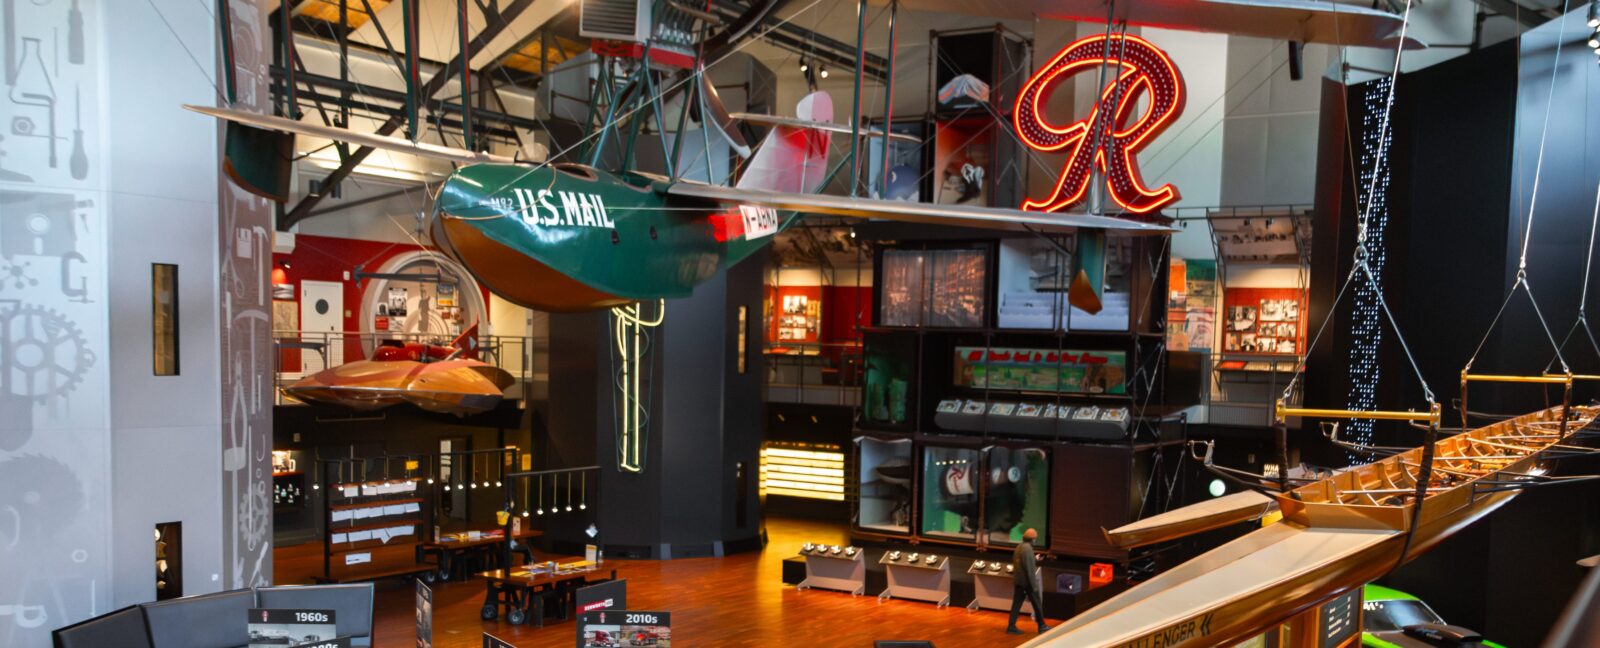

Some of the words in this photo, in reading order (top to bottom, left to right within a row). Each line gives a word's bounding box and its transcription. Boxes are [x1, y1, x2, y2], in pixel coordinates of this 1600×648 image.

[1013, 32, 1187, 213] R
[295, 612, 329, 622] 1960s
[626, 613, 658, 624] 2010s
